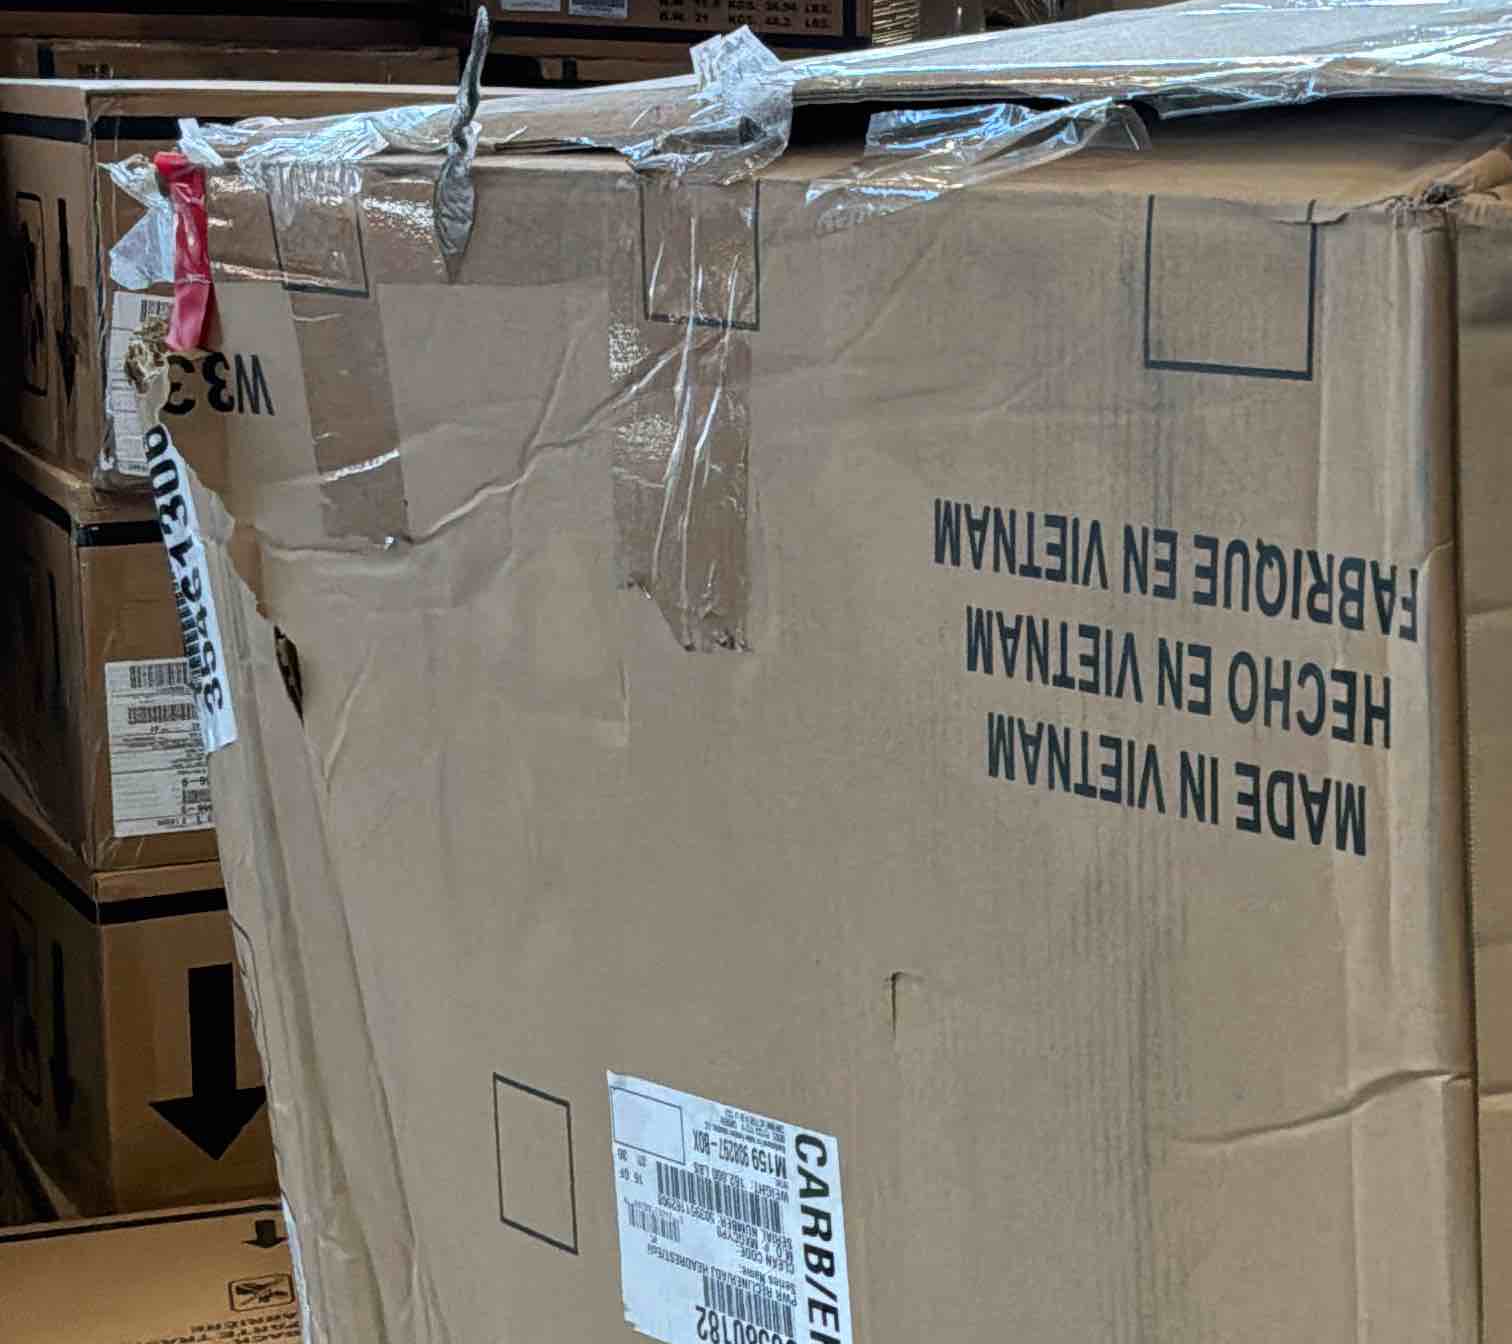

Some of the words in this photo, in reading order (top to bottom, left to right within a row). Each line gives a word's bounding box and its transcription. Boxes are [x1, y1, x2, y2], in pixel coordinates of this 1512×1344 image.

[162, 351, 275, 417] W33
[933, 497, 1109, 590] VIETNAM
[1122, 522, 1179, 601] EN
[1193, 532, 1420, 643] FABRIQUE
[965, 604, 1144, 704] VIETNAM
[1157, 636, 1213, 716] EN
[1227, 649, 1392, 749] HECHO
[986, 710, 1167, 815] VIETNAM
[1179, 749, 1220, 825] IN
[1234, 761, 1368, 857] MADE
